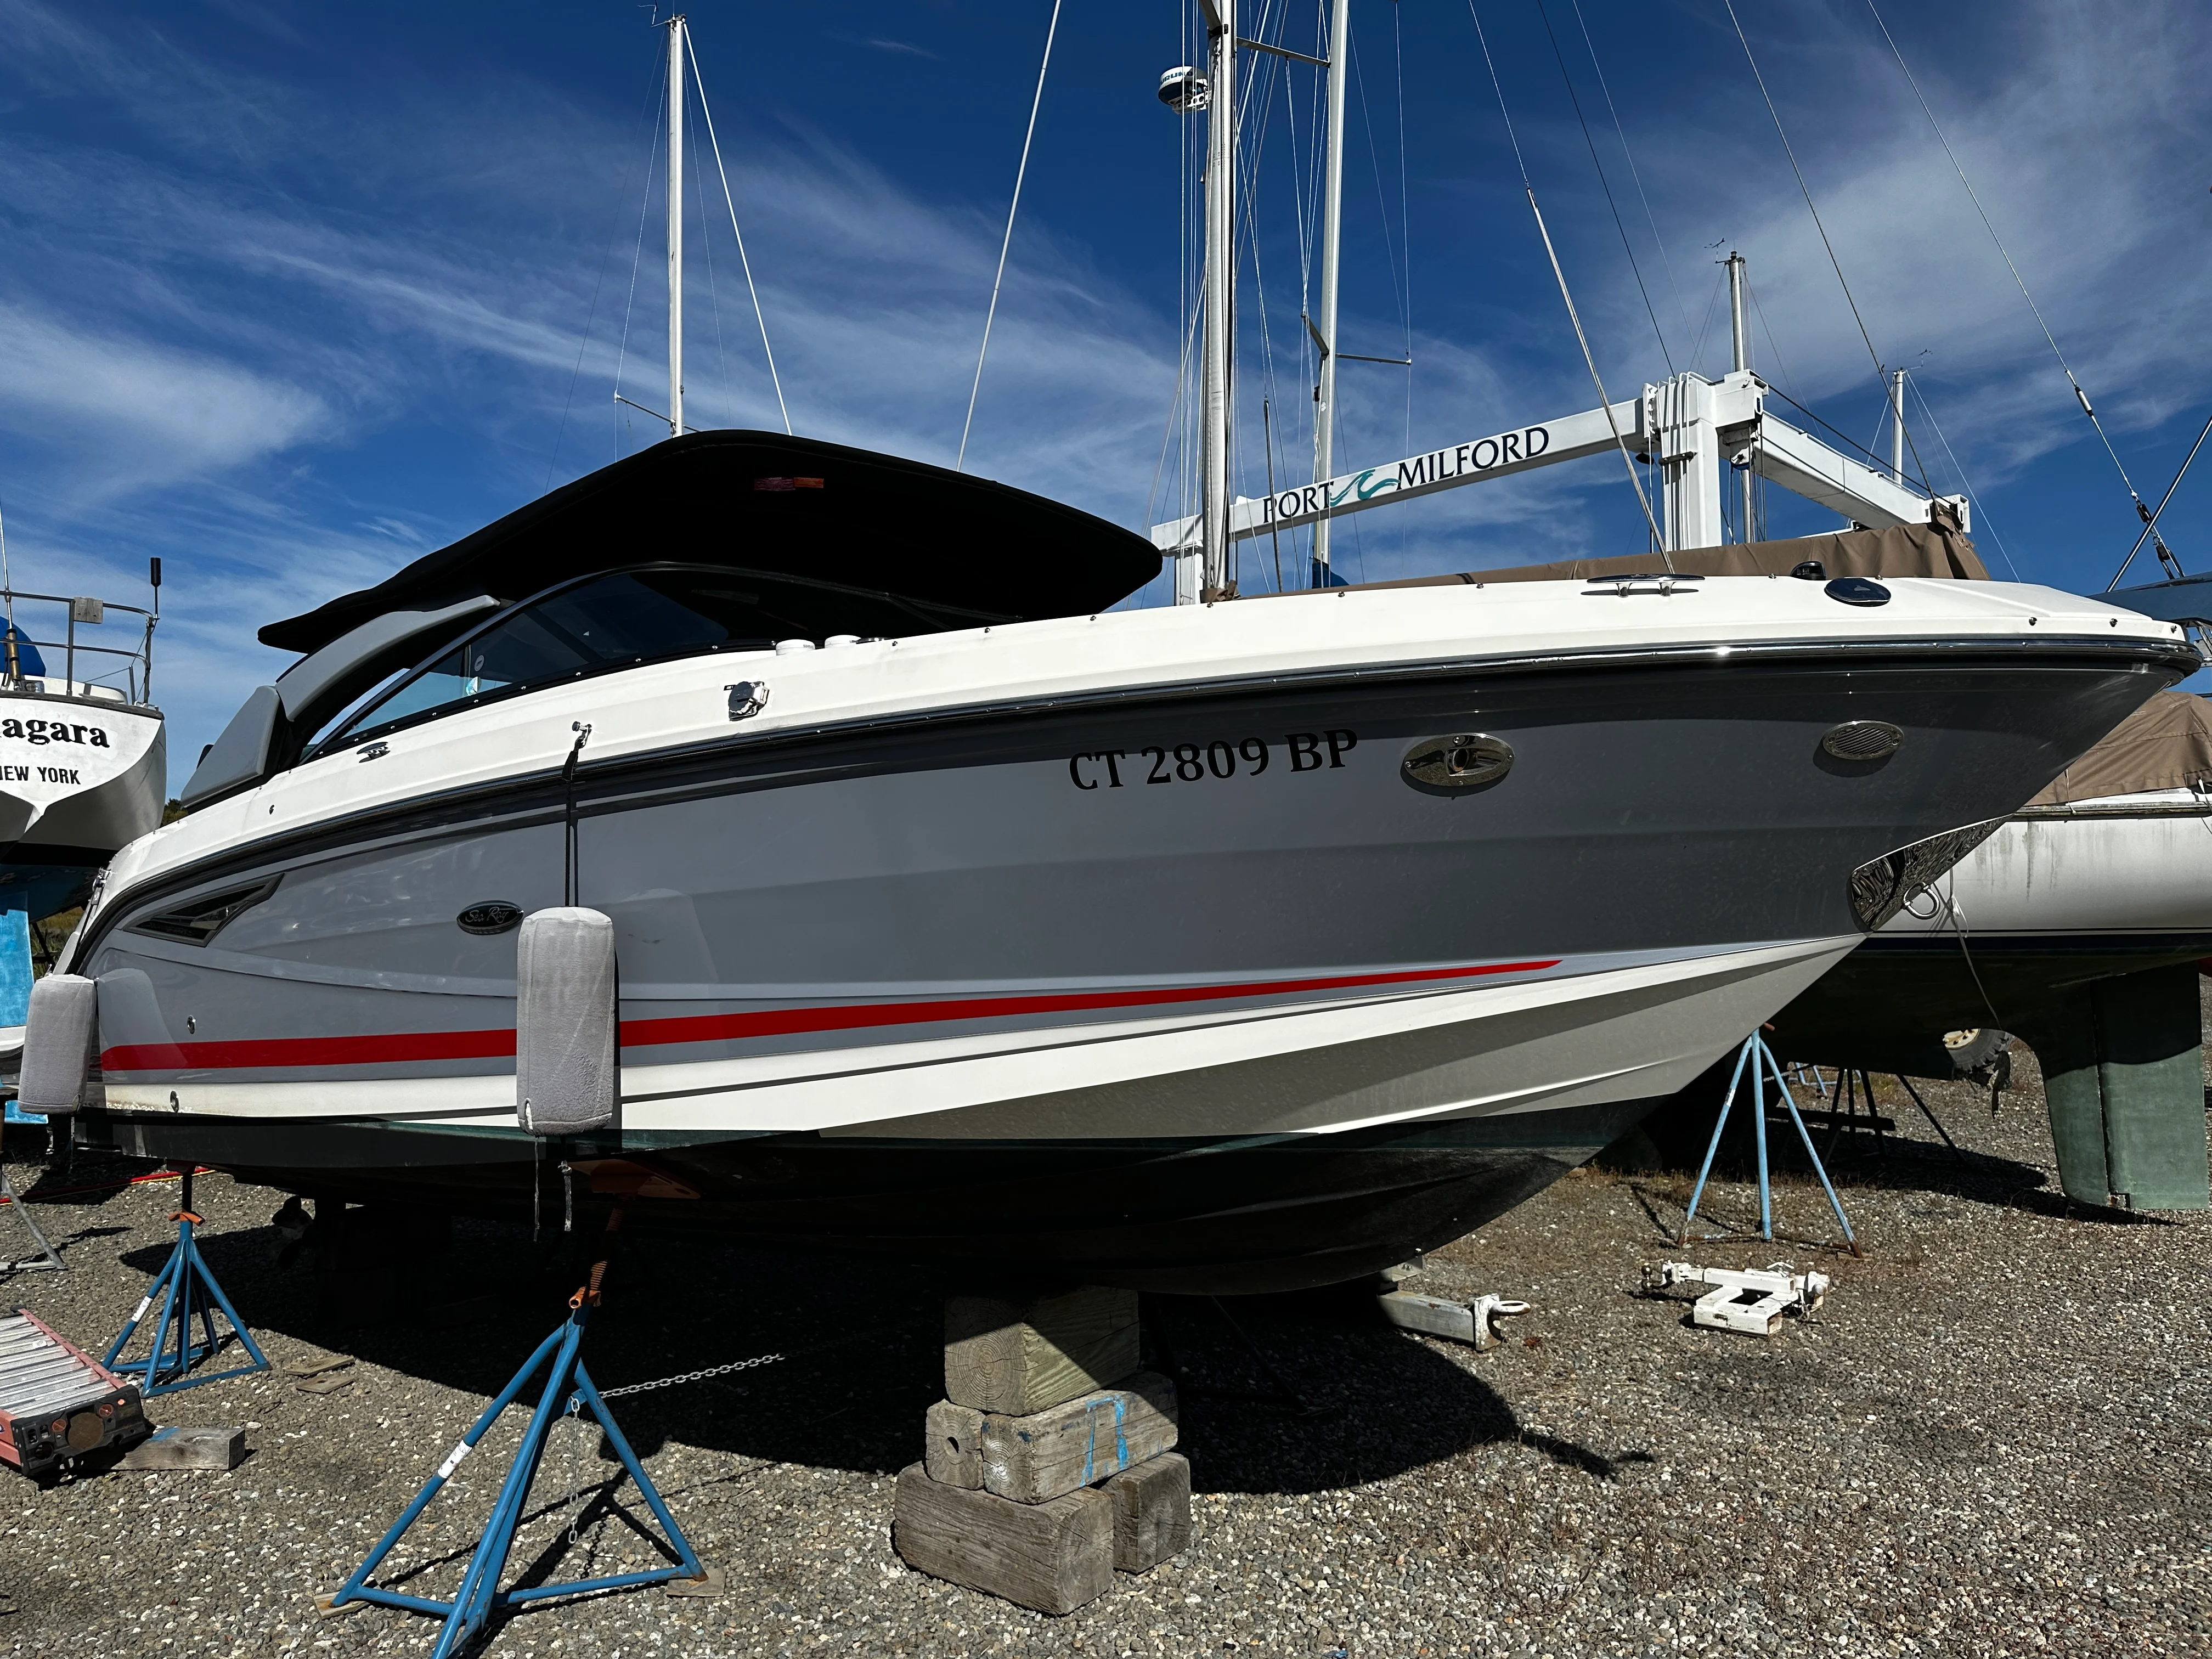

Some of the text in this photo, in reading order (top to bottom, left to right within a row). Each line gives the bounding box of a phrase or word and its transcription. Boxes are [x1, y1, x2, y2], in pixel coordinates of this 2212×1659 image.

[1263, 426, 1549, 523] PORT MILFORD
[0, 719, 110, 748] agara
[1069, 729, 1358, 791] CT 2809 BP
[0, 765, 81, 785] EW YORK
[465, 906, 509, 924] Sea Ray
